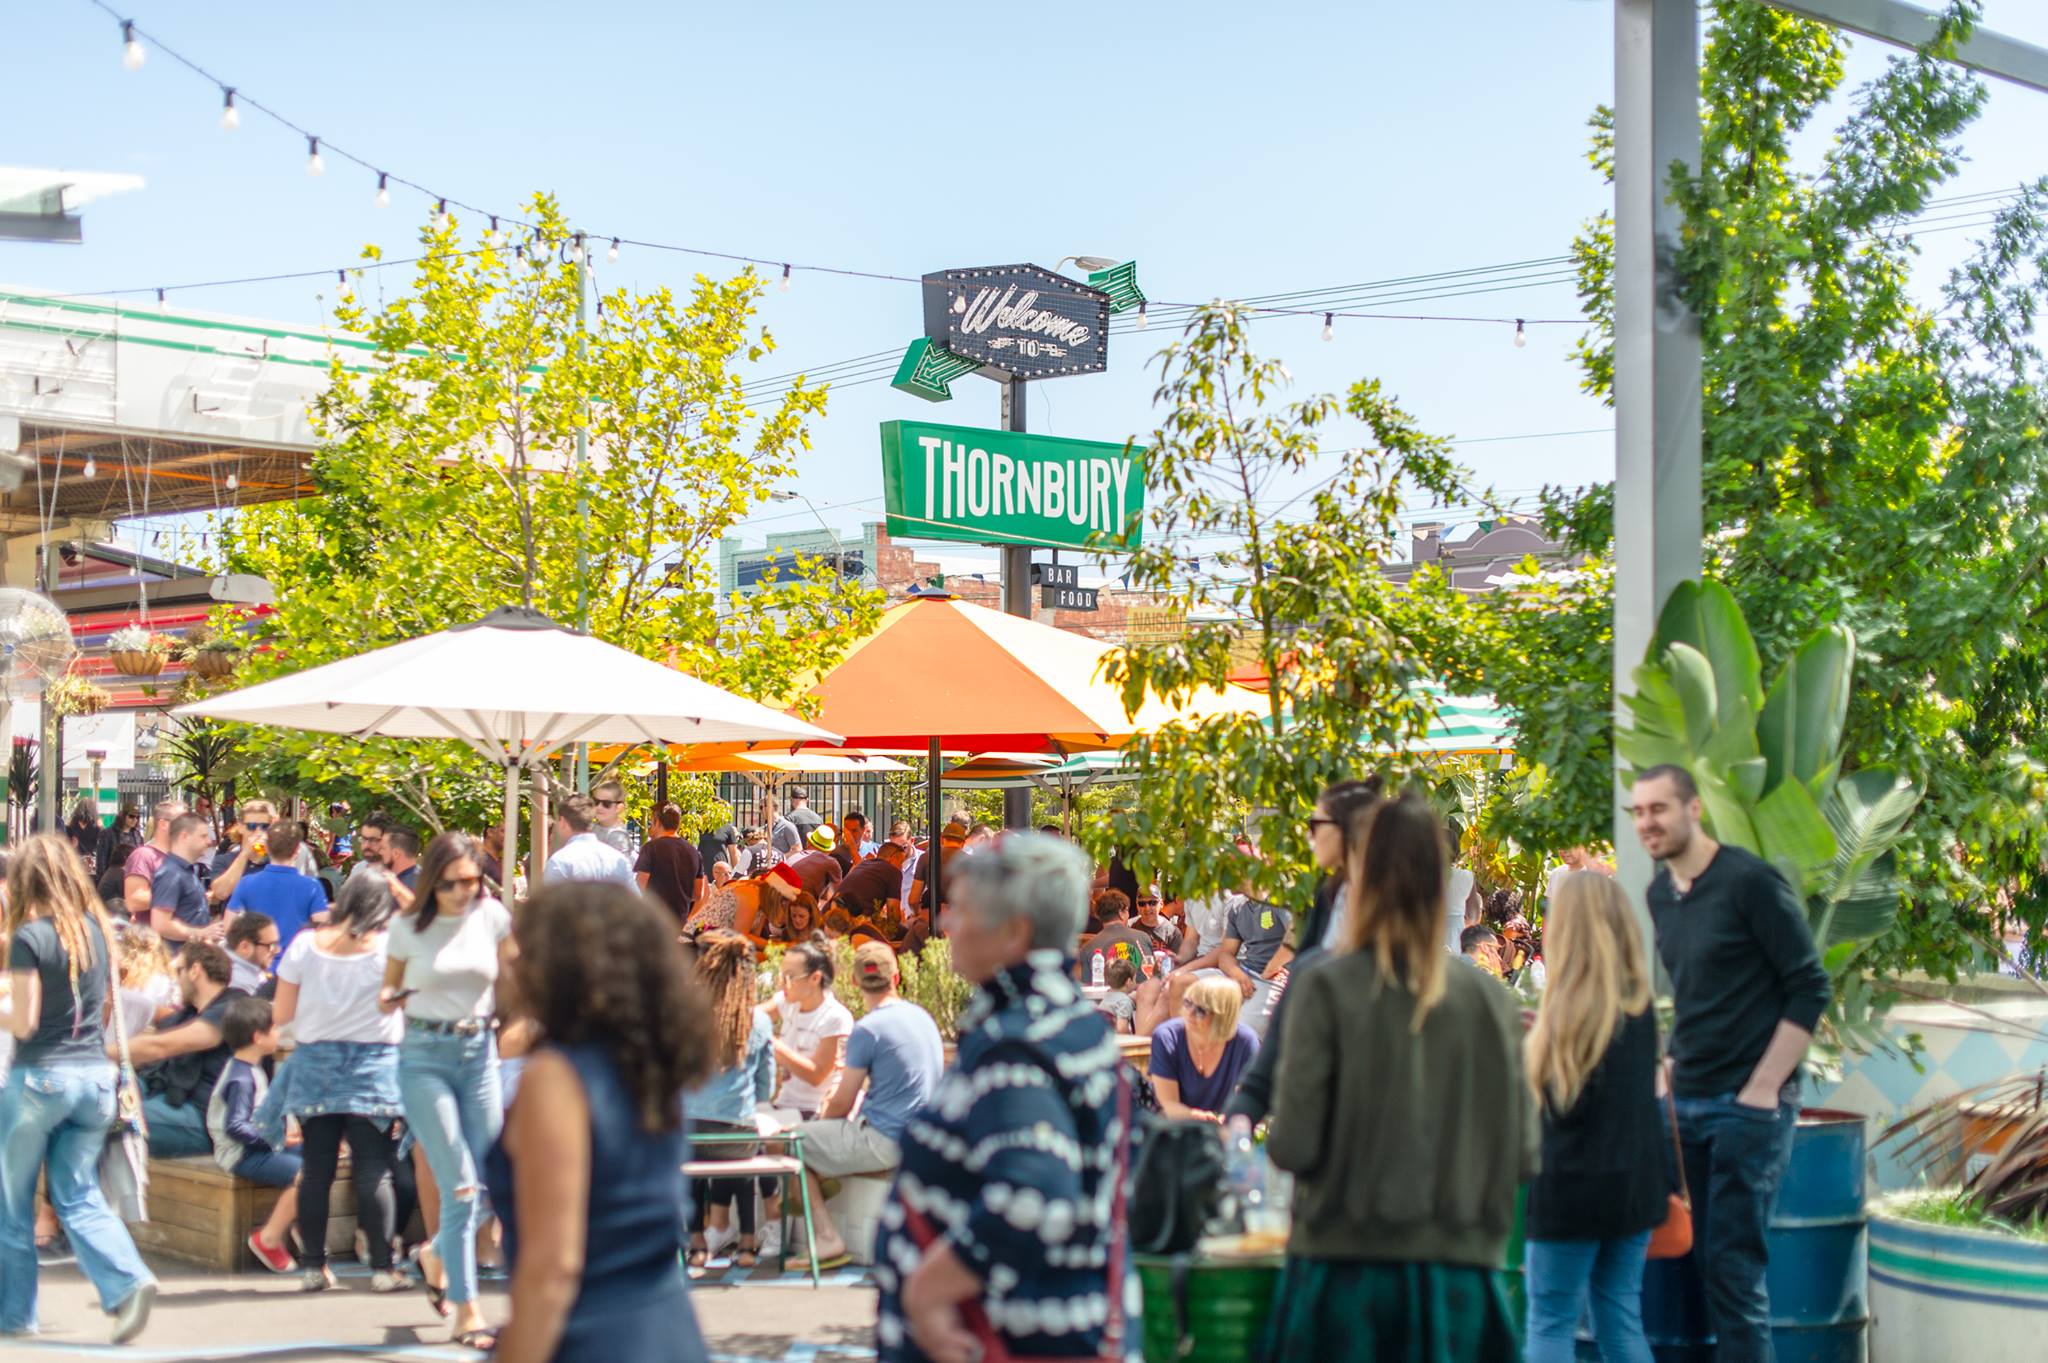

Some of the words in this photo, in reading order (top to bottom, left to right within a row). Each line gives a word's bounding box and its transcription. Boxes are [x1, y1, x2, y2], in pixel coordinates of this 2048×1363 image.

[961, 283, 1090, 347] Welcome
[1017, 338, 1039, 357] TO
[918, 436, 1131, 536] THORNBURY
[1048, 567, 1072, 584] BAR
[1060, 590, 1091, 607] FOOD
